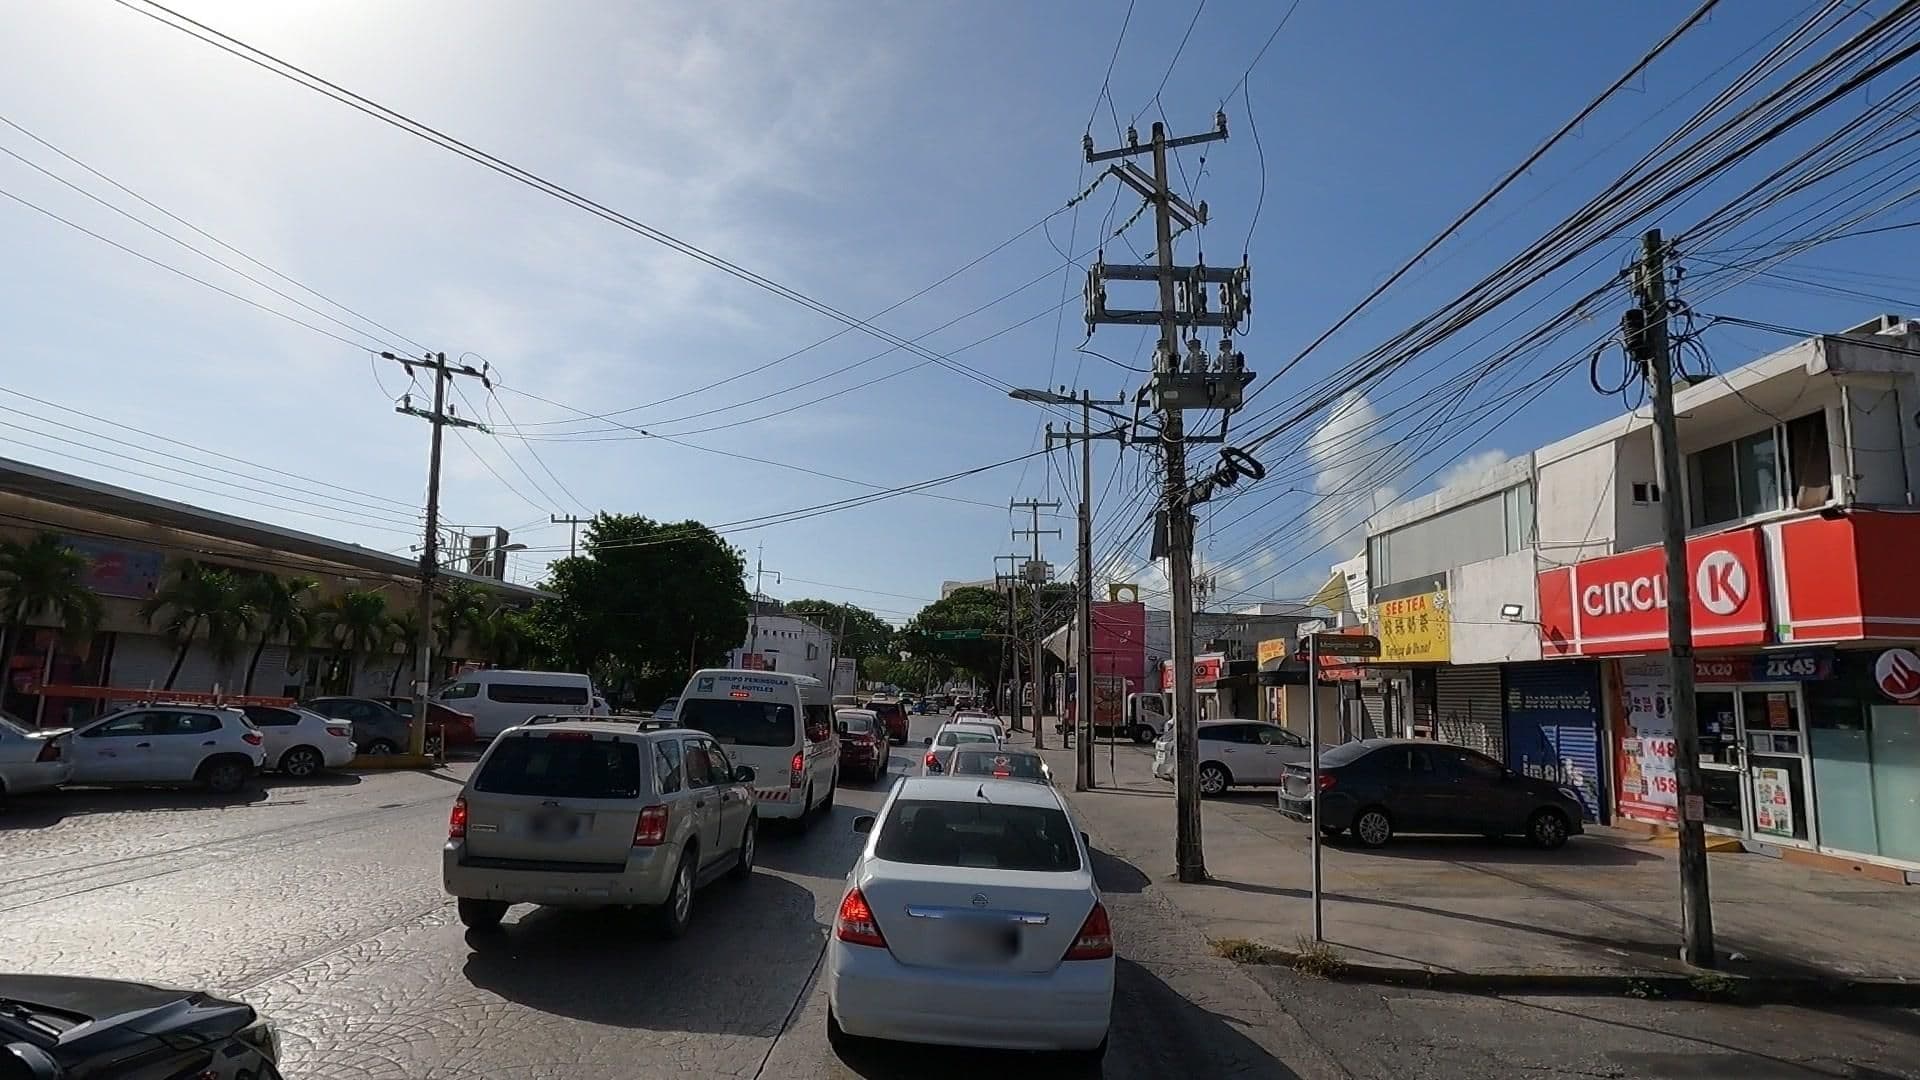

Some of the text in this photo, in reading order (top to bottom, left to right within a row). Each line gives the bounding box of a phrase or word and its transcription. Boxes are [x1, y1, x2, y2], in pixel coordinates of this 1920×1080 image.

[1583, 561, 1742, 617] CIRCL K
[1386, 596, 1426, 615] SEE TEA
[744, 676, 788, 686] PENINSULAR
